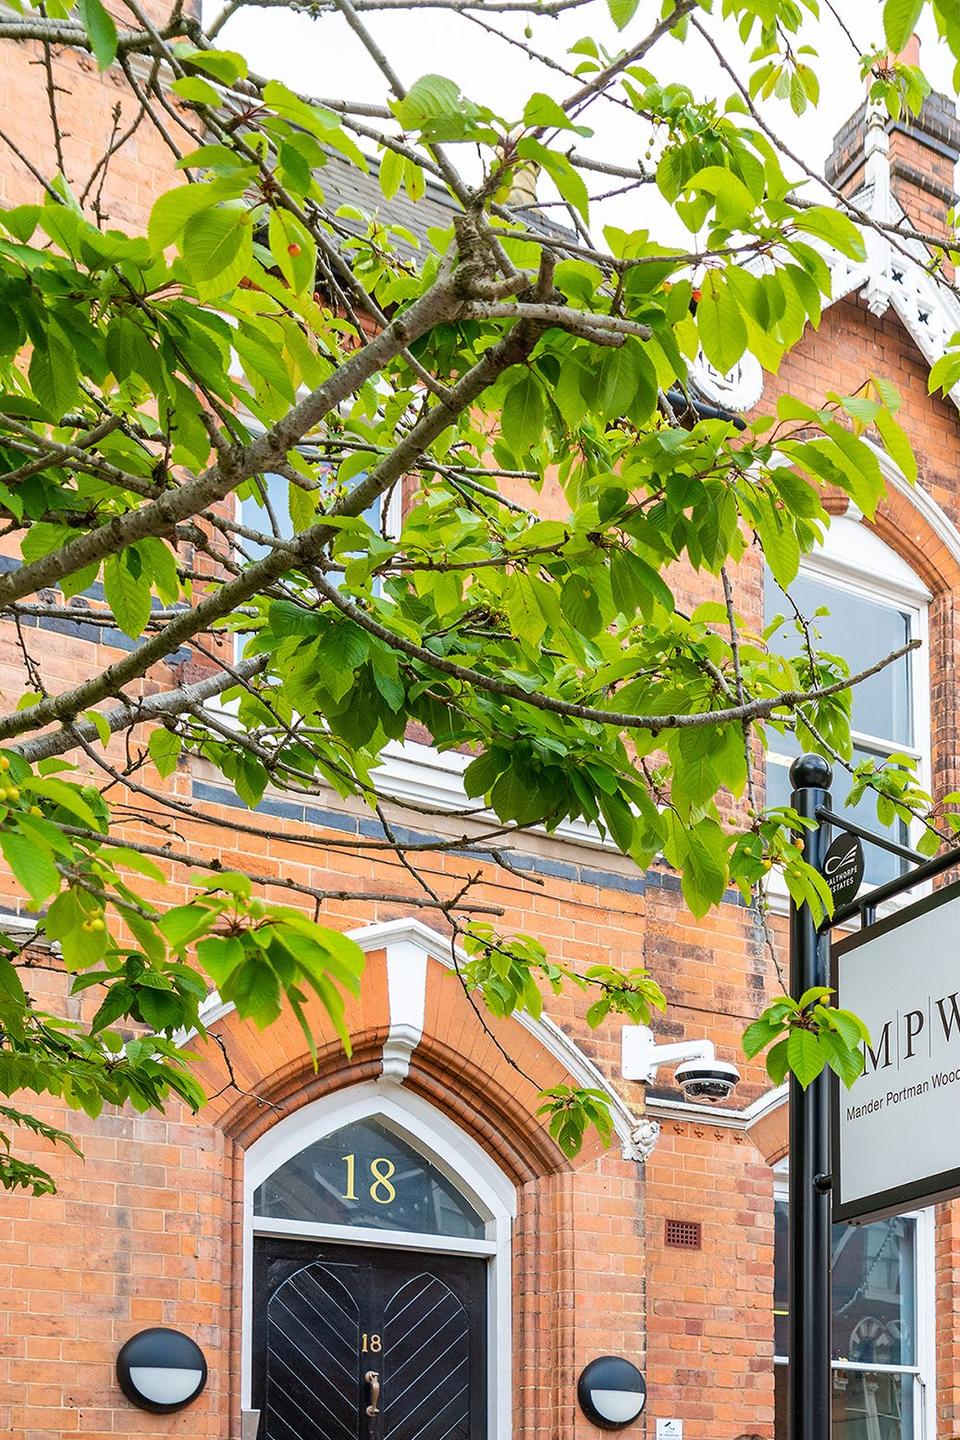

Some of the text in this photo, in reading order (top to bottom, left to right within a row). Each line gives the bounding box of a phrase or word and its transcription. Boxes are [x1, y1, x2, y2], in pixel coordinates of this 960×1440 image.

[827, 865, 858, 886] ALTHORPE
[846, 1098, 884, 1121] Mander
[886, 1081, 929, 1106] Portman
[342, 1154, 396, 1204] 18
[362, 1333, 382, 1352] 18
